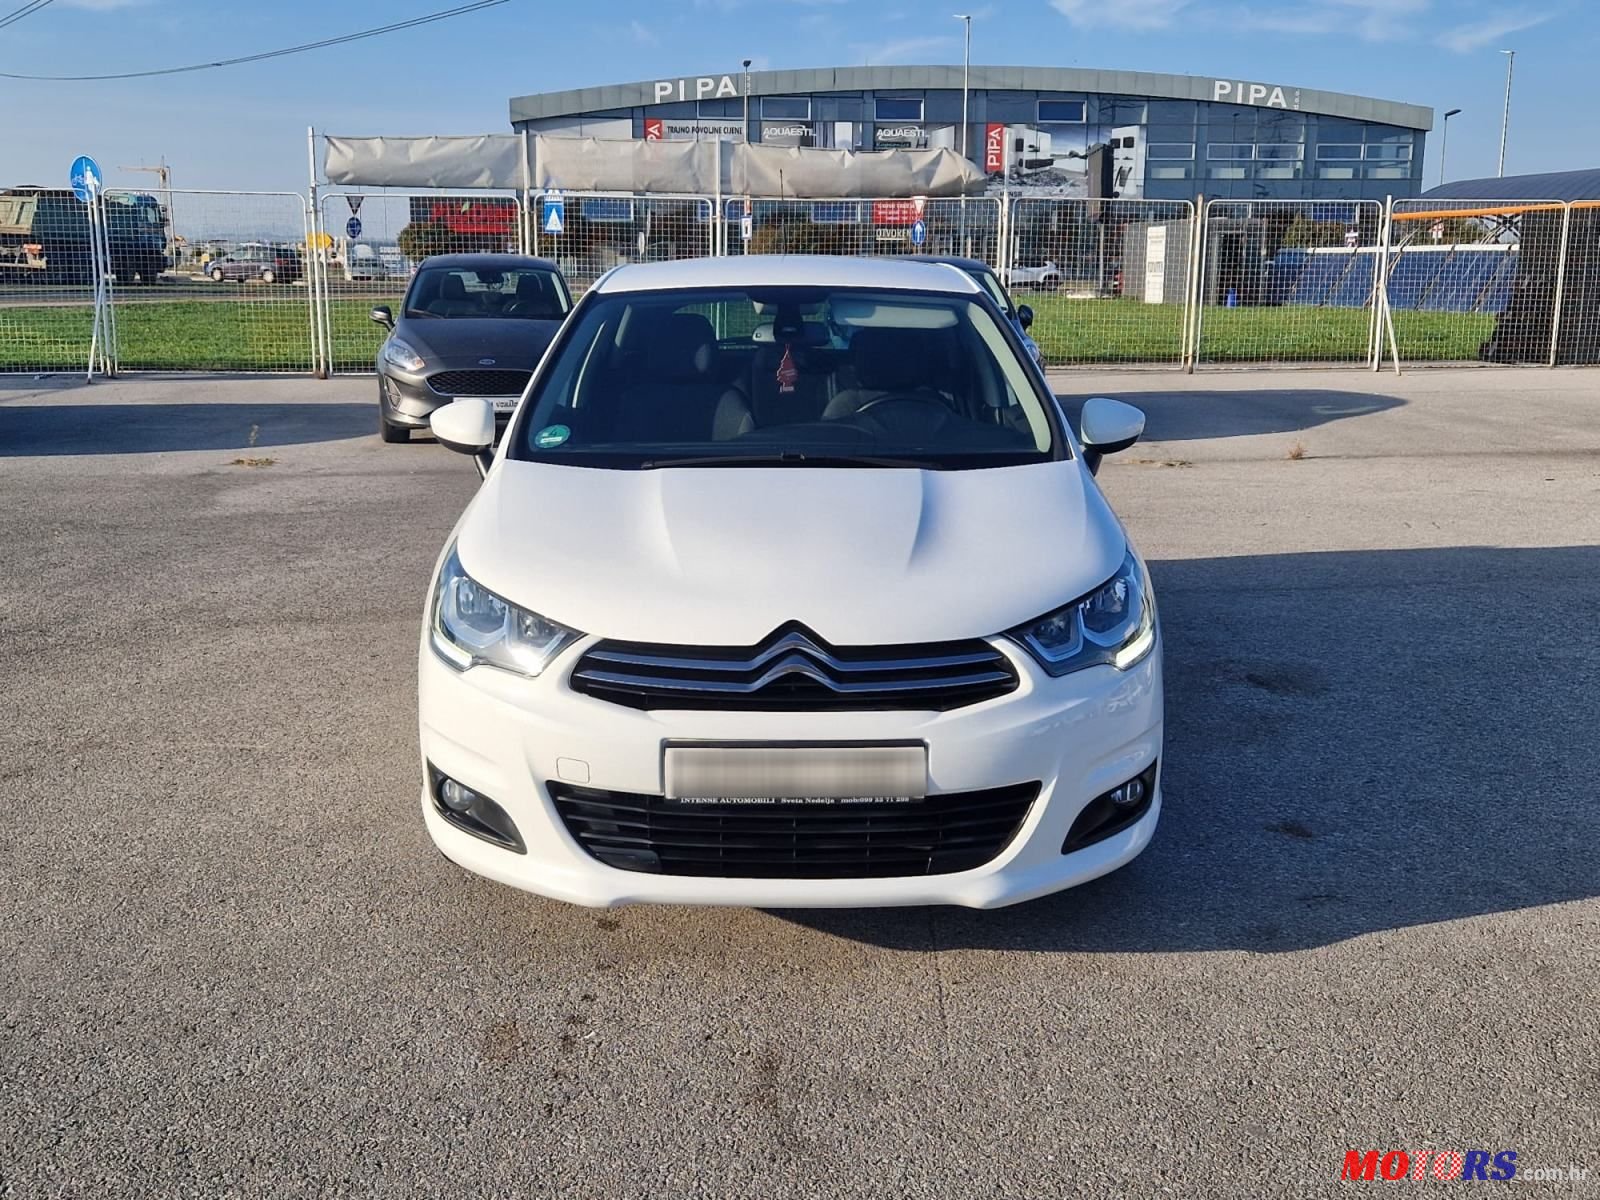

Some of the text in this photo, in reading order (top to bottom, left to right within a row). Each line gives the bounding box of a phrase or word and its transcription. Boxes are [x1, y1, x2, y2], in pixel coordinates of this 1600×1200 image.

[654, 75, 738, 104] PIPA
[1213, 80, 1287, 108] PIPA
[987, 127, 1002, 167] PIPA
